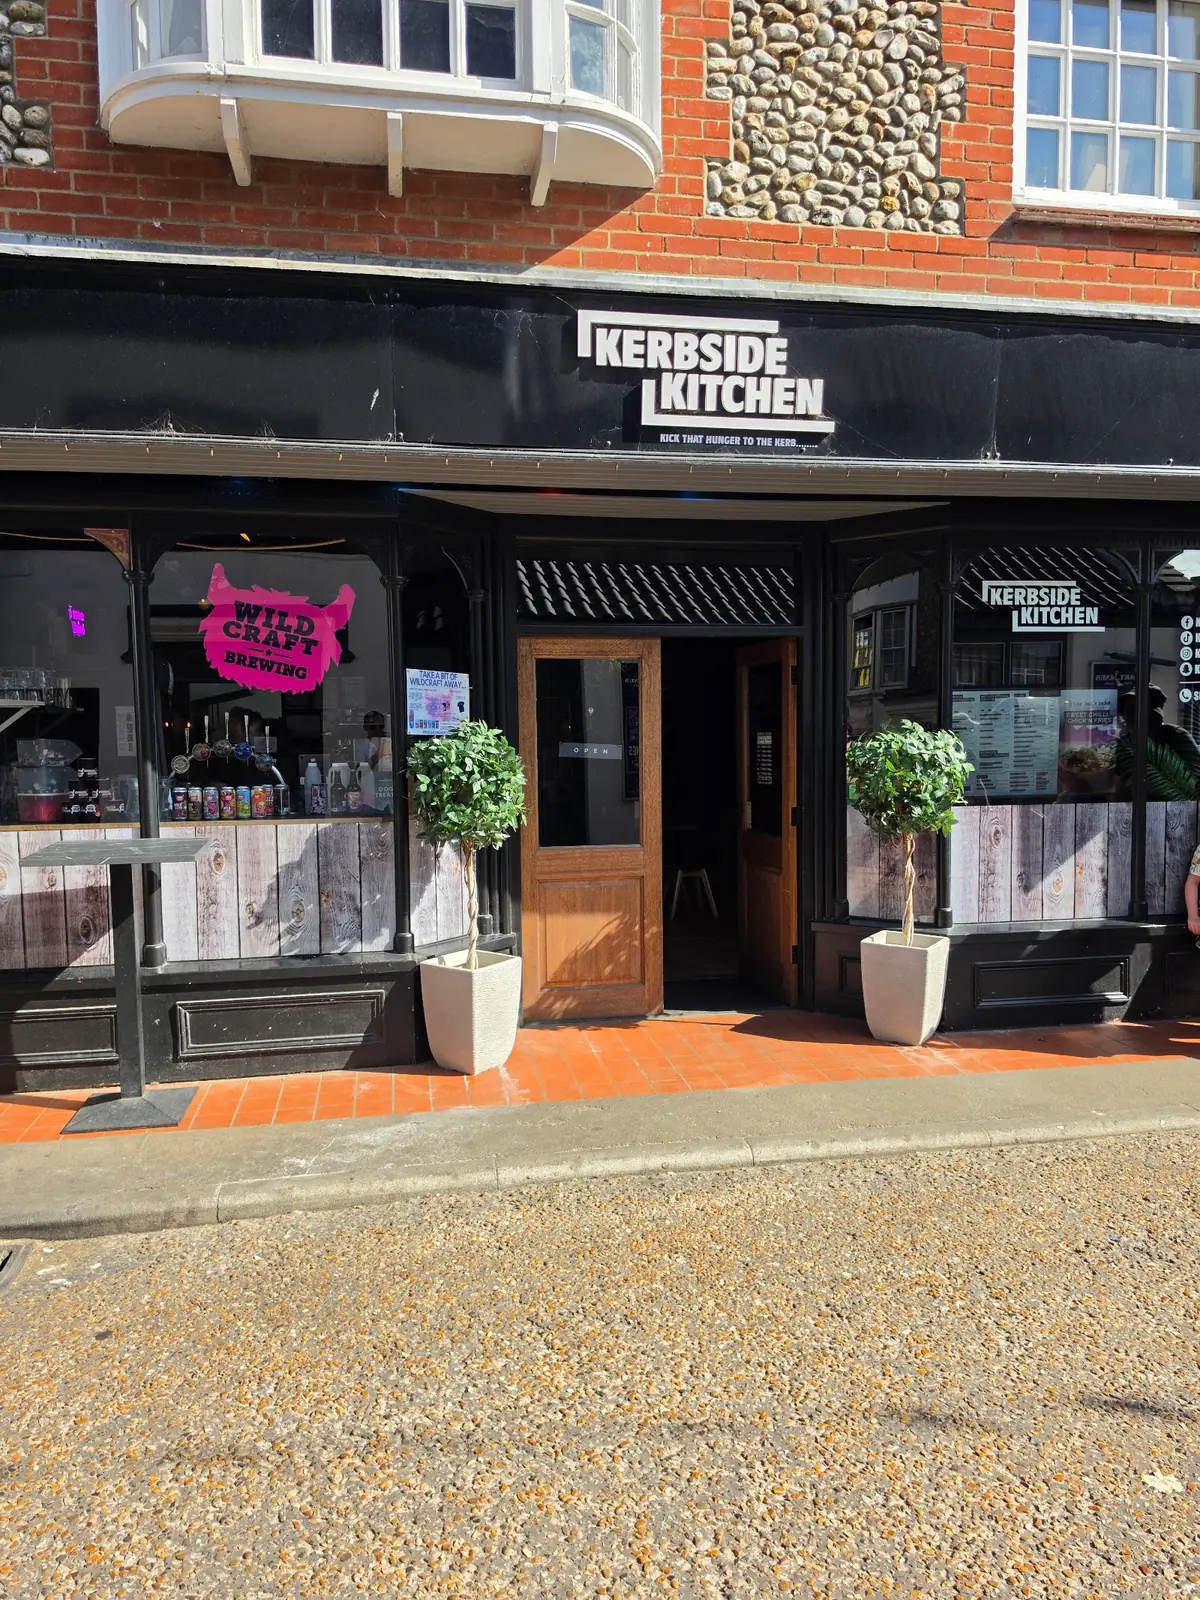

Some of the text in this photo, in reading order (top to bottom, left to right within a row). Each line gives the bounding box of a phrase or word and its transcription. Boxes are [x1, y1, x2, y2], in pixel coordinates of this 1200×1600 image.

[595, 328, 788, 375] KERBSIDE
[660, 372, 824, 415] KITCHEN
[660, 433, 680, 444] KICK
[682, 434, 704, 444] THAT
[705, 435, 741, 446] HUNGER
[743, 436, 754, 446] TO
[756, 437, 773, 447] THE
[990, 587, 1081, 606] KERBSIDE
[234, 600, 315, 637] WILD
[1021, 606, 1099, 625] KITCHEN
[222, 620, 319, 656] CRAFT
[223, 650, 308, 680] BREWING
[409, 677, 444, 687] WILDCRAFT
[419, 670, 435, 679] TAKE
[441, 672, 450, 680] BIT
[449, 672, 458, 681] OF
[573, 747, 608, 755] OPEN
